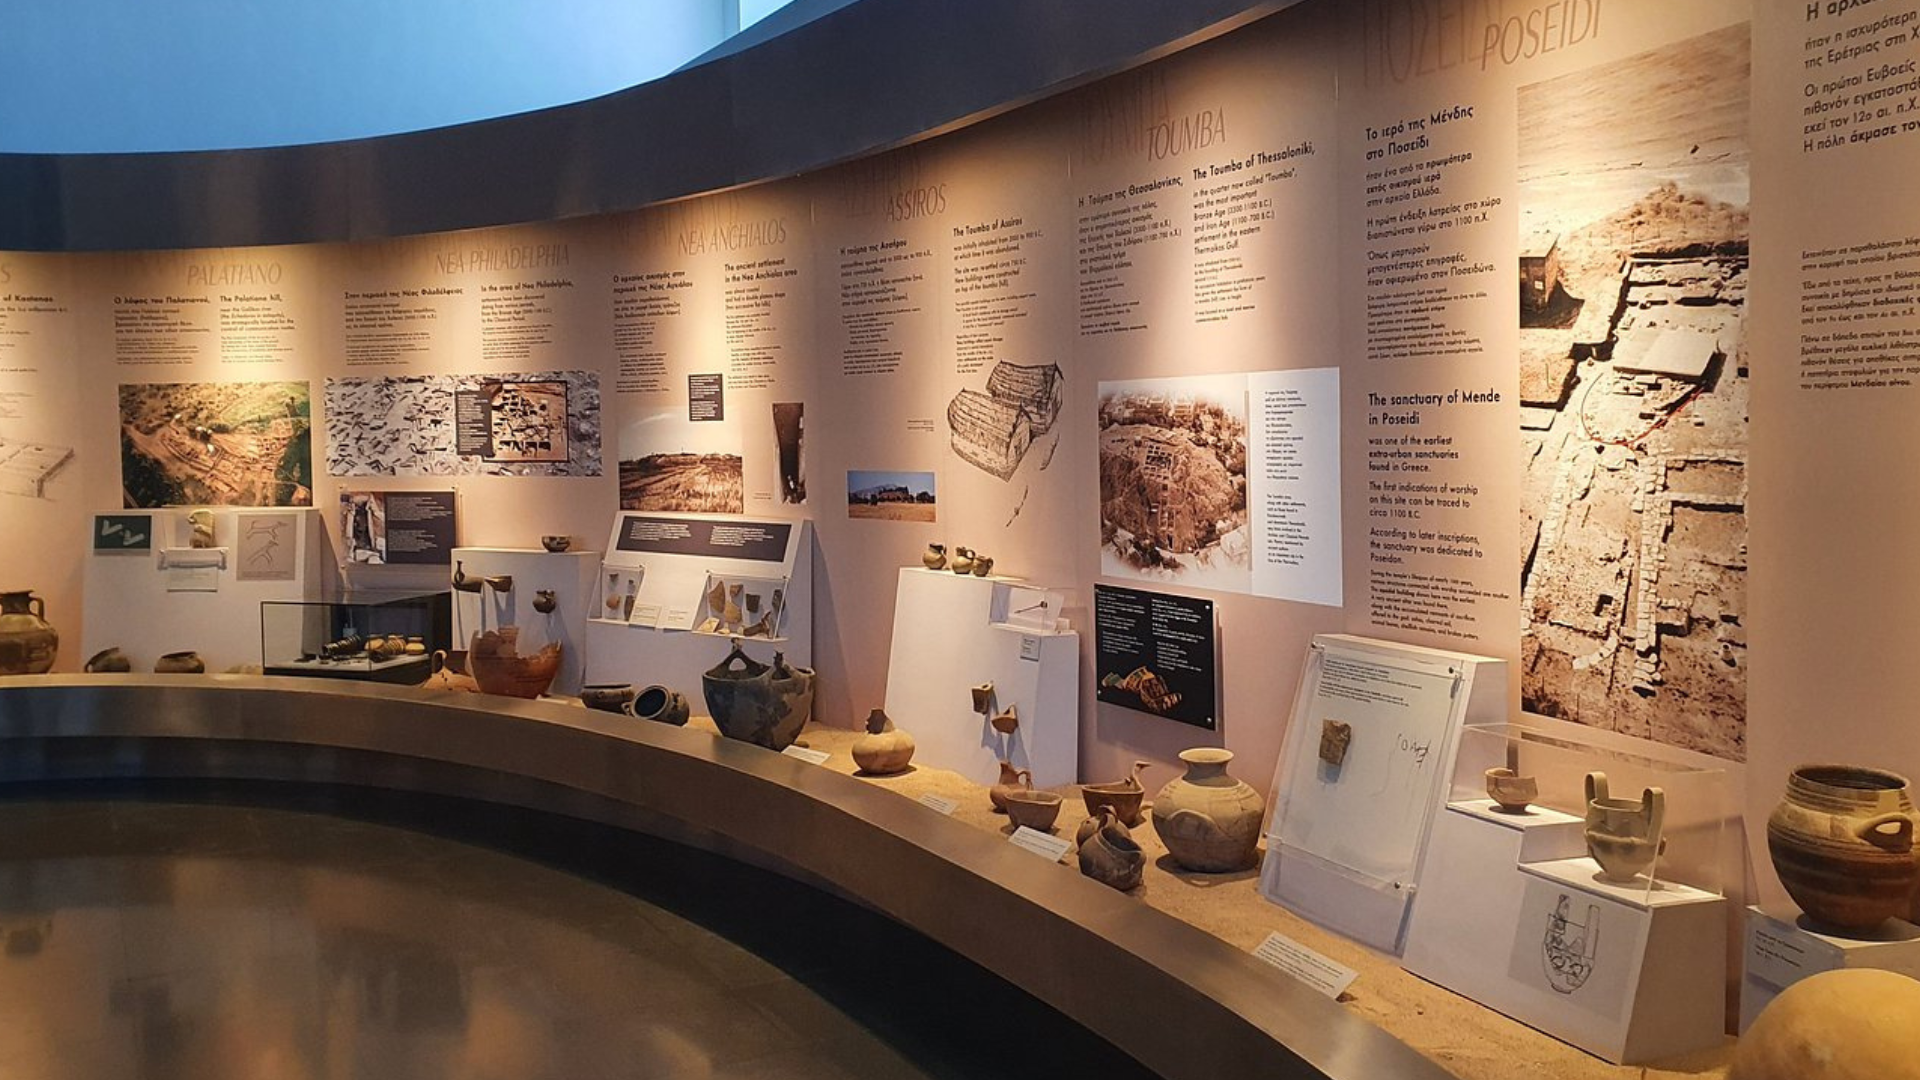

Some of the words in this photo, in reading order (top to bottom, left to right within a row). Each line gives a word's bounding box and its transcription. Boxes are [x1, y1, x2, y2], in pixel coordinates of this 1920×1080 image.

[1807, 2, 1819, 21] Η
[1481, 0, 1600, 71] POSEIDI
[1805, 36, 1830, 50] ήταν
[1846, 11, 1918, 39] ισχυρότερη
[1804, 57, 1823, 69] της
[1827, 43, 1880, 64] Ερέτριας
[1884, 33, 1906, 48] στη
[1804, 84, 1818, 97] Οι
[1822, 75, 1863, 95] πρώτοι
[1867, 59, 1916, 82] Ευβοείς
[1804, 95, 1850, 116] πιθανόν
[1366, 127, 1378, 141] Το
[1382, 119, 1405, 139] ιερό
[1408, 117, 1426, 132] της
[1430, 106, 1474, 126] Μένδης
[1804, 118, 1826, 135] εκεί
[1830, 116, 1849, 129] τον
[1147, 105, 1226, 162] TOUMBA
[1804, 138, 1813, 153] Η
[1817, 135, 1845, 150] πόλη
[1850, 125, 1898, 143] άκμασε
[1366, 146, 1384, 161] στο
[1388, 135, 1429, 155] Ποσείδι
[1193, 168, 1207, 180] The
[1210, 159, 1242, 176] Toumba
[1246, 154, 1255, 168] of
[1257, 141, 1315, 165] Thessaloniki,
[1399, 164, 1414, 175] από
[1200, 186, 1208, 197] the
[1210, 183, 1230, 196] quarter
[1232, 182, 1244, 190] now
[1245, 175, 1264, 187] called
[1367, 183, 1386, 194] εκτός
[886, 183, 947, 222] ASSIROS
[1193, 200, 1205, 209] was
[1206, 197, 1215, 207] the
[1216, 195, 1229, 205] most
[1230, 189, 1258, 202] important
[1194, 209, 1213, 221] Bronze
[1214, 207, 1226, 220] Age
[1367, 218, 1373, 227] Η
[1375, 215, 1397, 230] πρώτη
[1399, 208, 1427, 222] ένδειξη
[1429, 203, 1461, 218] λατρείας
[953, 227, 964, 237] The
[965, 222, 990, 236] Toumba
[992, 219, 998, 230] of
[1000, 217, 1023, 228] Assiros
[1194, 222, 1205, 232] and
[1219, 219, 1230, 230] Age
[1194, 230, 1221, 245] settlement
[1228, 228, 1237, 238] the
[1239, 225, 1261, 236] eastern
[1367, 226, 1415, 241] διαπιστώνεται
[1417, 223, 1437, 234] γύρω
[678, 231, 705, 256] NEA
[711, 220, 786, 253] ANCHIALOS
[435, 252, 464, 275] NEA
[469, 244, 570, 272] PHILADELPHIA
[1391, 243, 1430, 259] μαρτυρούν
[187, 262, 282, 286] PALATIANO
[725, 264, 734, 272] The
[1367, 259, 1424, 276] μεταγενέστερες
[1368, 392, 1387, 407] The
[1390, 393, 1443, 407] sanctuary
[1447, 389, 1459, 404] of
[1462, 387, 1501, 404] Mende
[1368, 412, 1378, 425] in
[1382, 410, 1420, 425] Poseidi
[1368, 437, 1382, 446] was
[1384, 437, 1398, 446] one
[1400, 434, 1408, 446] of
[1410, 435, 1421, 446] the
[1423, 435, 1453, 446] earliest
[1368, 449, 1412, 458] extra-urban
[1415, 449, 1459, 459] sanctuaries
[1368, 461, 1390, 472] found
[1392, 461, 1399, 471] in
[1401, 462, 1431, 472] Greece.
[1369, 481, 1381, 491] The
[1383, 480, 1397, 491] first
[1399, 482, 1438, 493] indications
[1440, 483, 1448, 493] of
[1449, 484, 1479, 496] worship
[1369, 496, 1379, 504] on
[1380, 494, 1392, 504] this
[1394, 494, 1406, 505] site
[1409, 497, 1422, 506] can
[1425, 496, 1435, 507] be
[1437, 497, 1460, 507] traced
[1462, 498, 1470, 508] to
[1369, 507, 1388, 517] circa
[1369, 527, 1407, 540] According
[1409, 531, 1417, 539] to
[1419, 529, 1436, 540] later
[1438, 531, 1480, 545] inscriptions,
[1370, 540, 1381, 550] the
[1383, 541, 1418, 554] sanctuary
[1420, 546, 1435, 554] was
[1437, 545, 1473, 558] dedicated
[1475, 549, 1483, 558] to
[1370, 552, 1404, 565] Poseidon.
